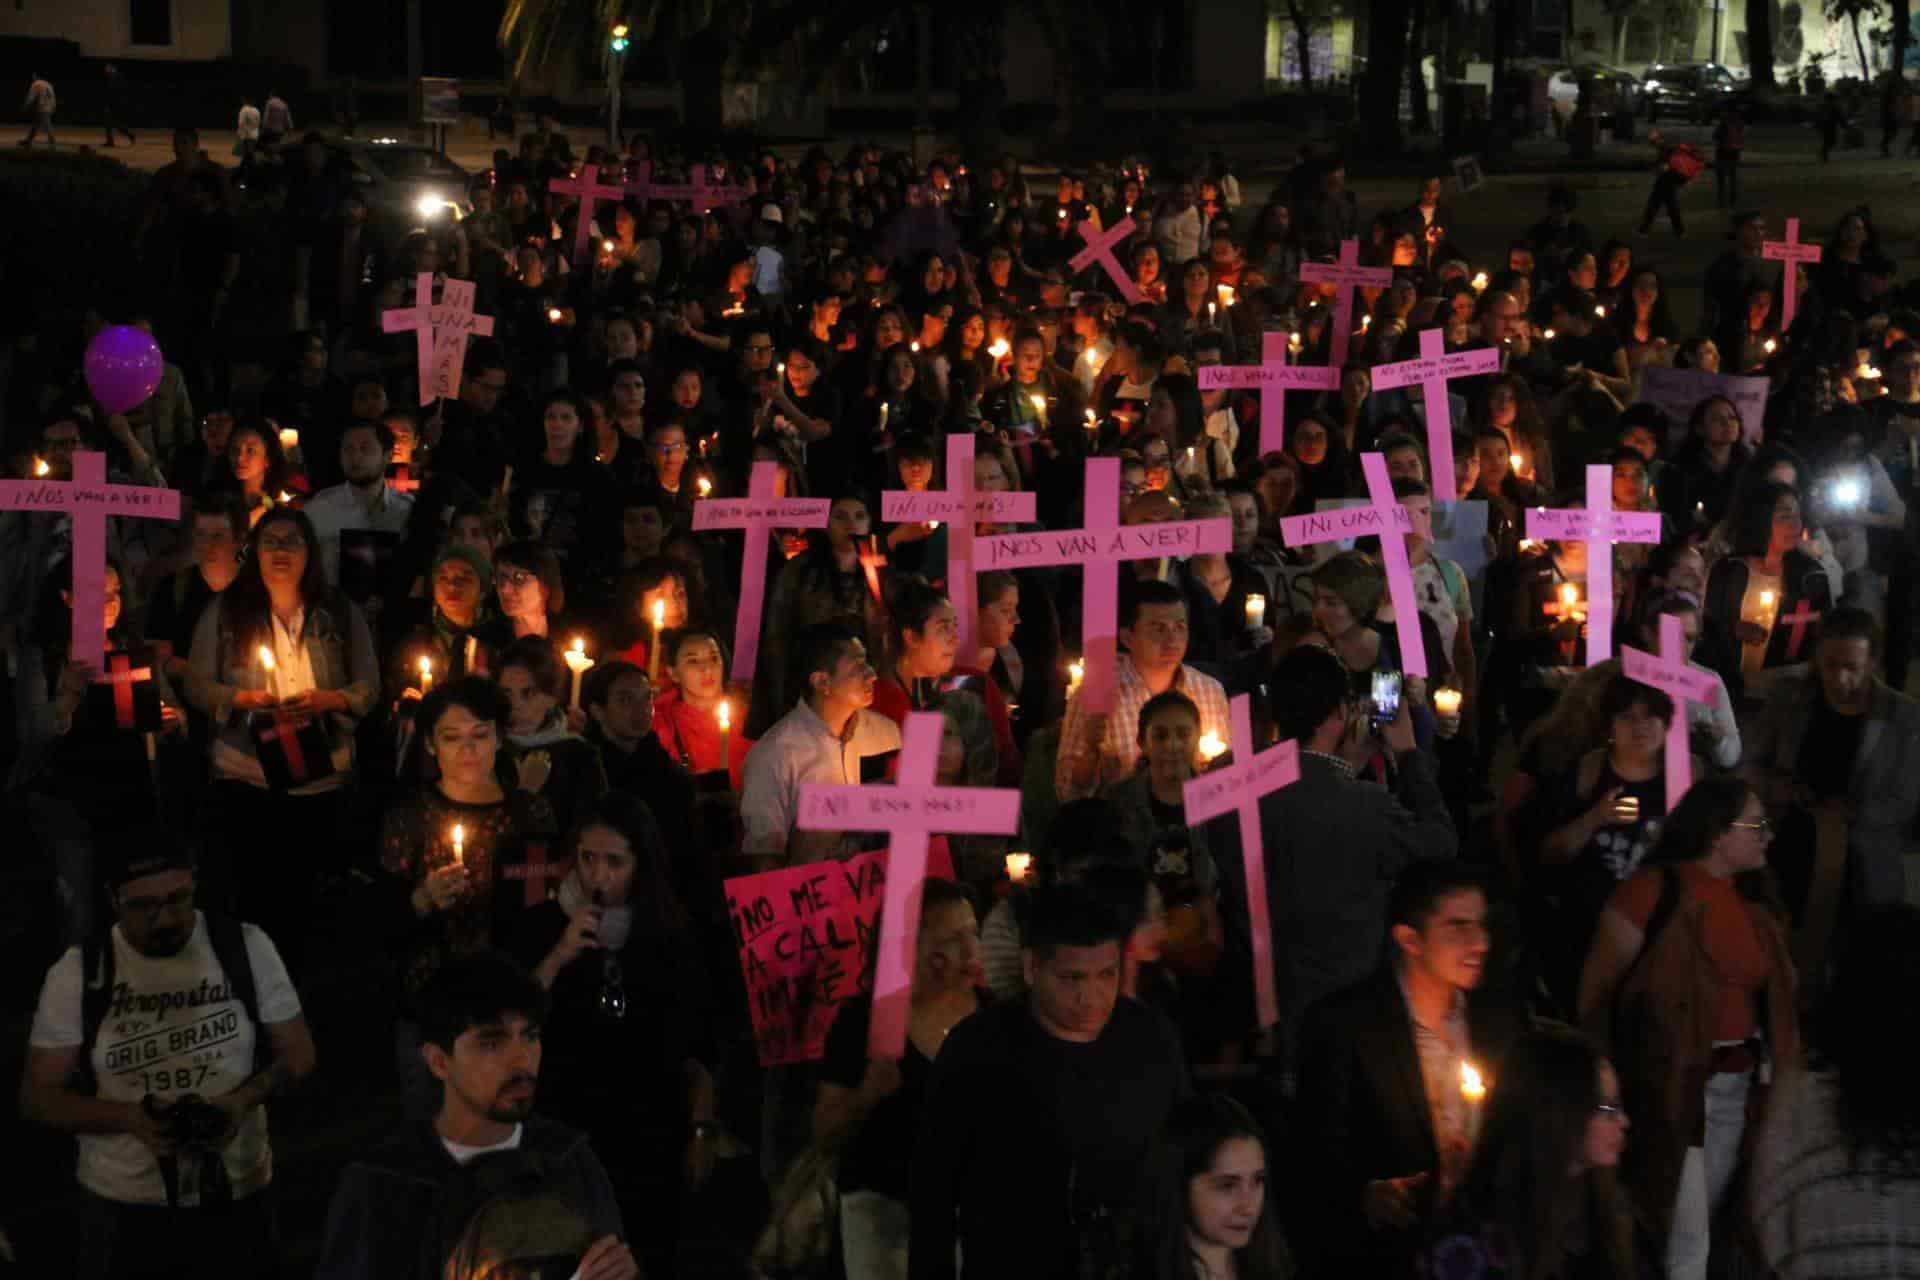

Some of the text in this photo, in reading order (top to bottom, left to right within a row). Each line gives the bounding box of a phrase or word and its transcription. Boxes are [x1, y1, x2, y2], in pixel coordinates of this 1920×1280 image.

[445, 288, 471, 308] NI
[427, 311, 477, 330] UNA
[72, 488, 105, 503] VAN
[109, 492, 121, 503] A
[925, 501, 966, 514] UNA
[1341, 508, 1386, 529] UNA
[1056, 534, 1098, 557] VAN
[1108, 531, 1127, 553] A
[789, 873, 830, 918] ME
[168, 1011, 238, 1053] BRAND
